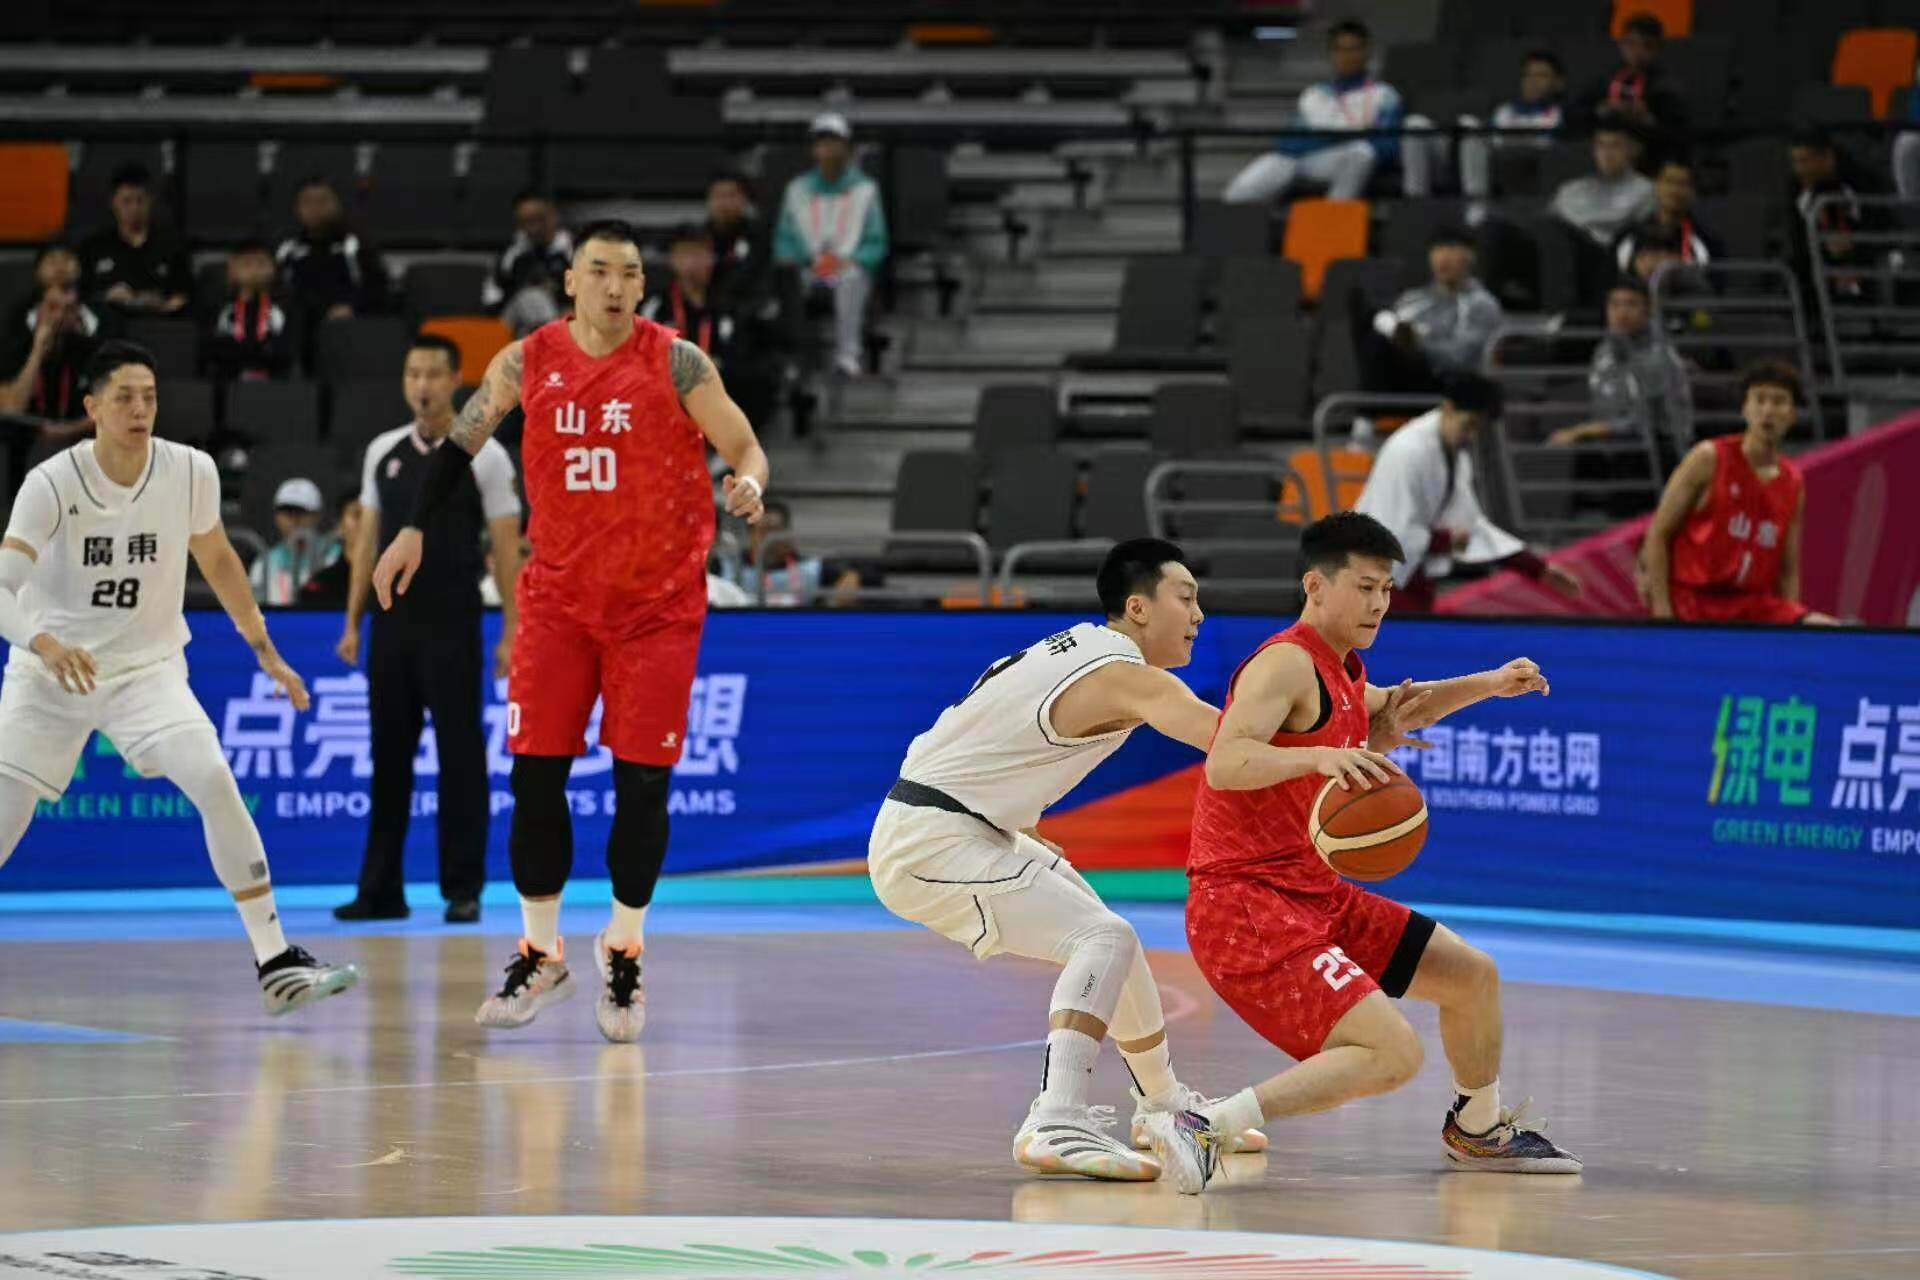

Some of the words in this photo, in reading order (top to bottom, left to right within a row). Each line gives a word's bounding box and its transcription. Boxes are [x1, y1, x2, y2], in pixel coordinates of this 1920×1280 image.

[555, 398, 632, 436] 山东
[564, 446, 617, 491] 20
[83, 533, 157, 566] 廣東
[91, 578, 140, 609] 28
[507, 702, 521, 737] 0
[1707, 695, 1816, 804] 绿电
[36, 793, 121, 818] REEN
[131, 793, 261, 818] ENEY
[276, 791, 439, 818] EMPOER
[1712, 817, 1778, 845] GREEN
[1784, 822, 1863, 850] ENERGY
[1871, 827, 1920, 856] EMP
